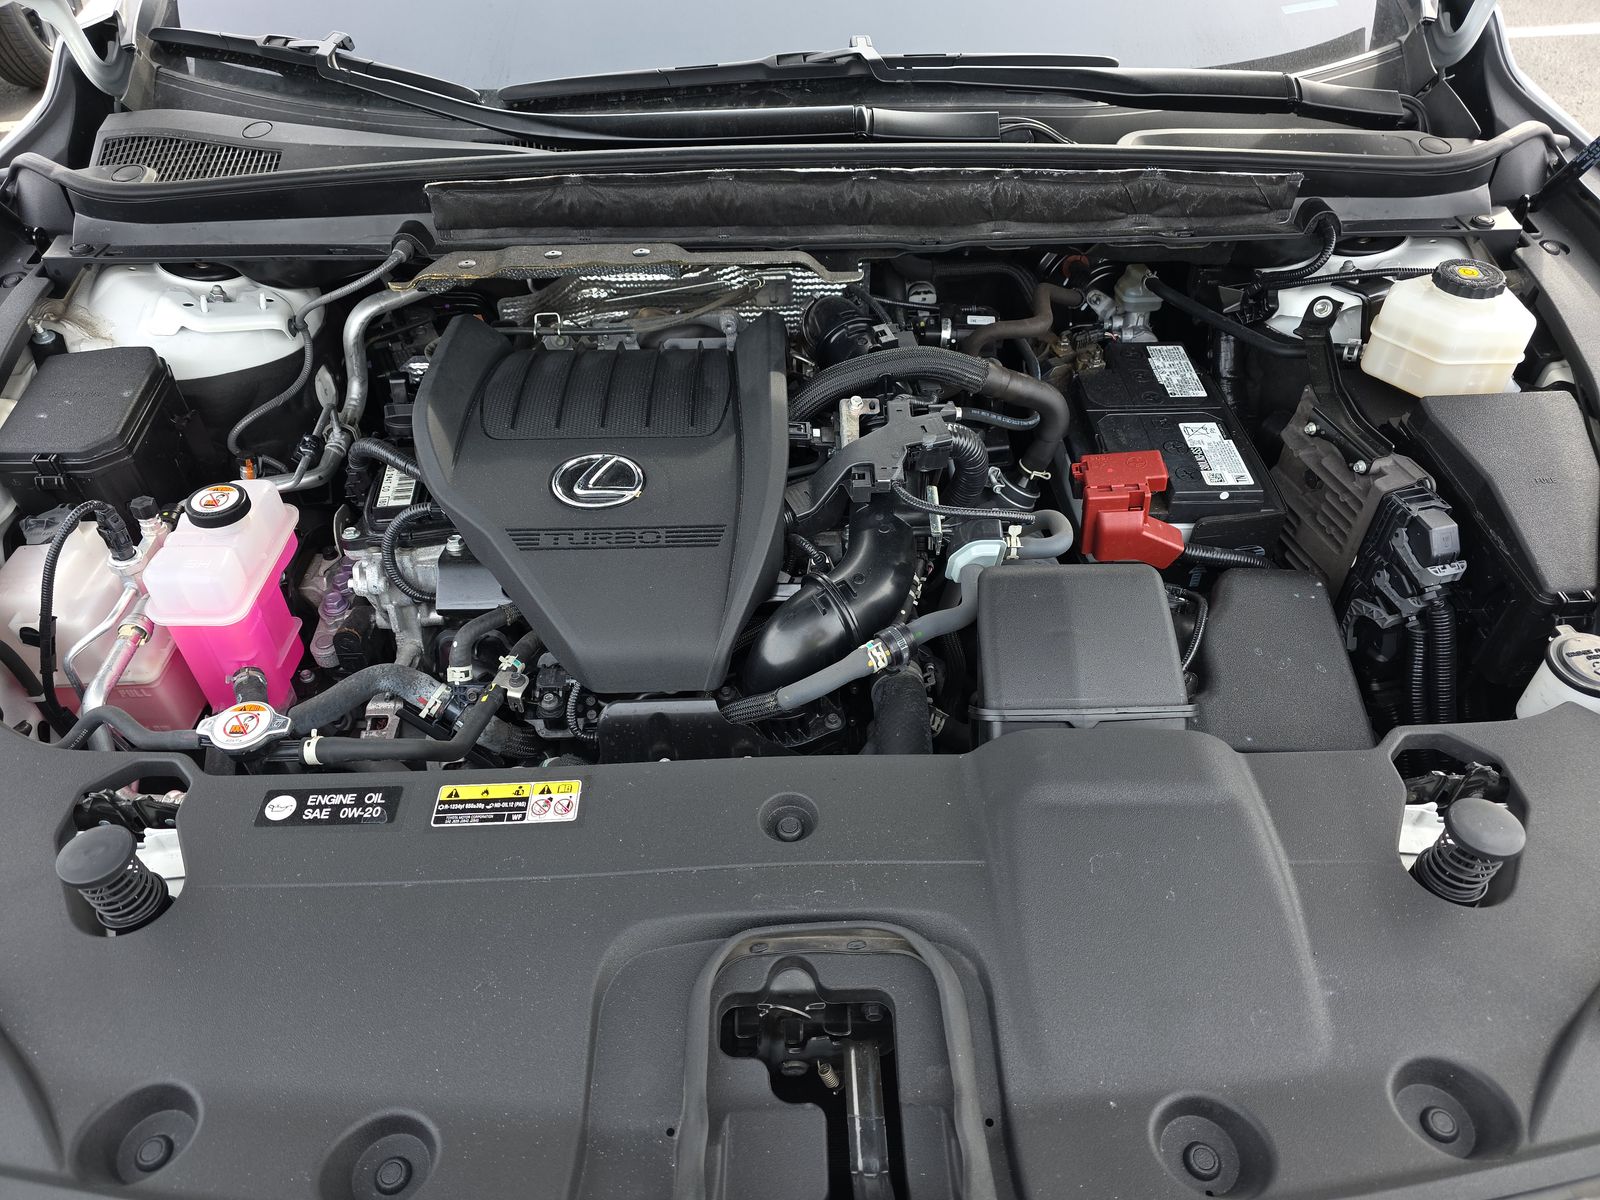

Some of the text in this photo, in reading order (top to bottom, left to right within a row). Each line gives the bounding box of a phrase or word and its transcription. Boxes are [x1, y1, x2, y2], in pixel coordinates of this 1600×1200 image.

[543, 530, 662, 546] TURBO
[119, 688, 151, 697] FULL
[307, 792, 386, 806] ENGINE OIL
[302, 806, 381, 820] SAE 0W-20
